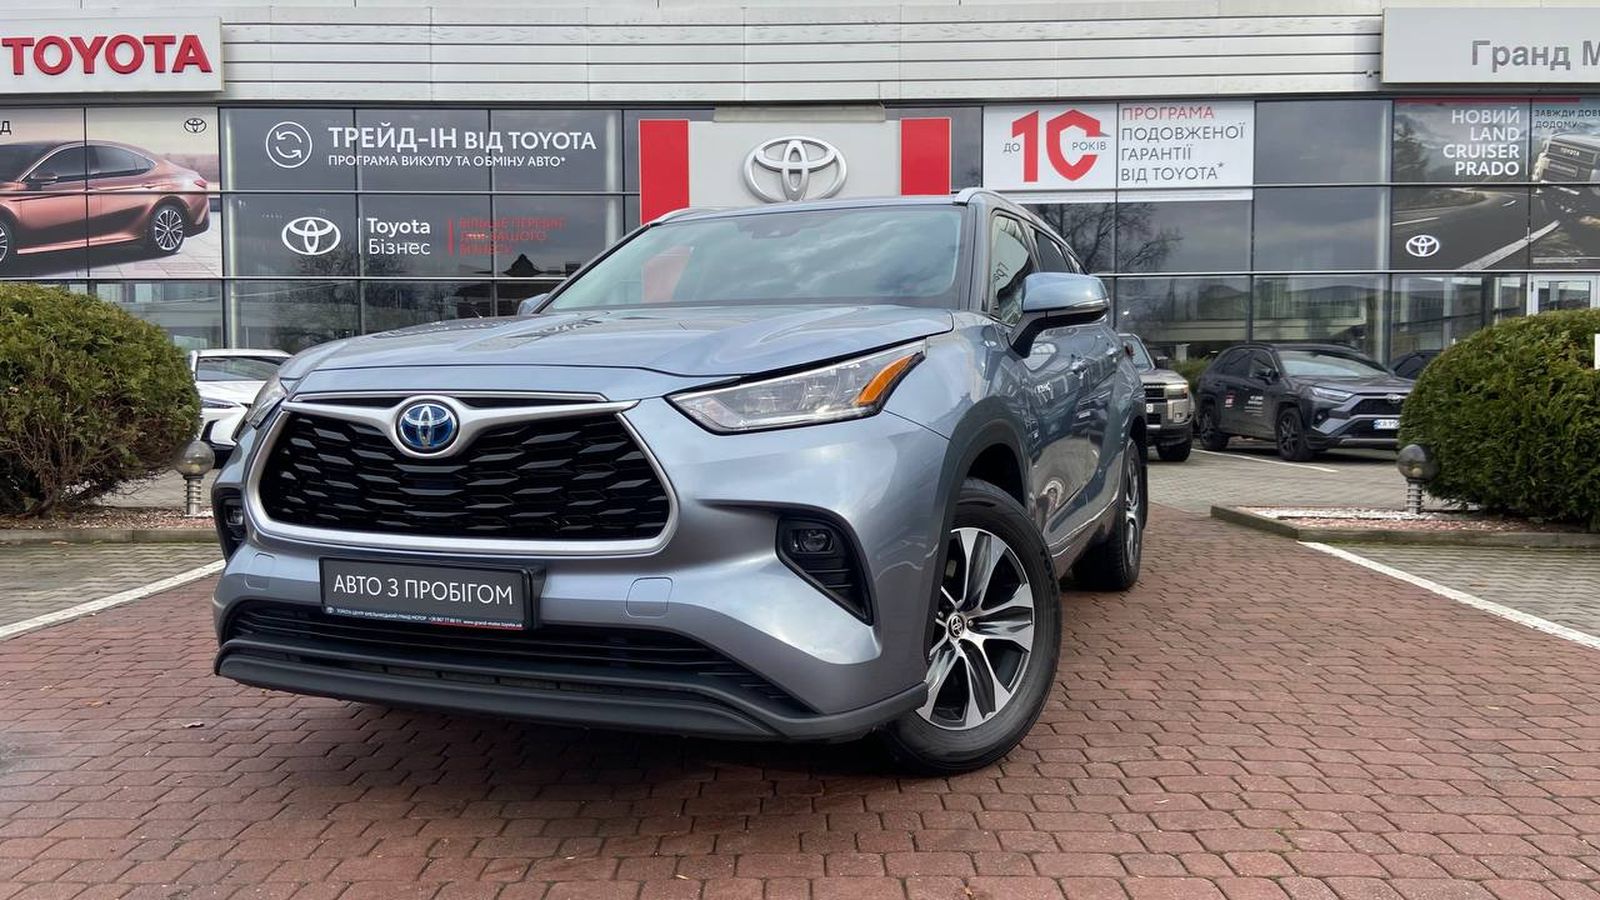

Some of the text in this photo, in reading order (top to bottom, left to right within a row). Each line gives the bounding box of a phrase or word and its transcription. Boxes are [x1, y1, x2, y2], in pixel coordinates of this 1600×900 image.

[2, 35, 212, 76] TOYOTA
[1471, 40, 1571, 73] Гранд
[1122, 106, 1215, 121] ПРОГРАМА
[1451, 106, 1520, 124] НОВИЙ
[1534, 109, 1575, 118] ЗАВЖДИ
[328, 123, 597, 152] ТРЕЙД-ІН ВІД TOYOTA
[1121, 122, 1246, 142] ПОДОВЖЕНОЇ
[1470, 127, 1520, 141] LAND
[1004, 142, 1021, 153] ДО
[1072, 141, 1107, 151] РОКІВ
[1121, 144, 1193, 161] ГАРАНТІЇ
[1443, 144, 1520, 159] CRUISER
[328, 155, 398, 166] ПРОГРАМА
[401, 155, 453, 167] ВИКУПУ
[455, 156, 471, 166] ТА
[473, 156, 525, 167] ОБМІНУ
[1455, 161, 1520, 176] PRADO
[1121, 167, 1147, 184] ВІД
[367, 217, 431, 238] Toyota
[369, 239, 431, 257] Бізнес
[333, 574, 513, 605] АВТО З ПРОБІГОМ
